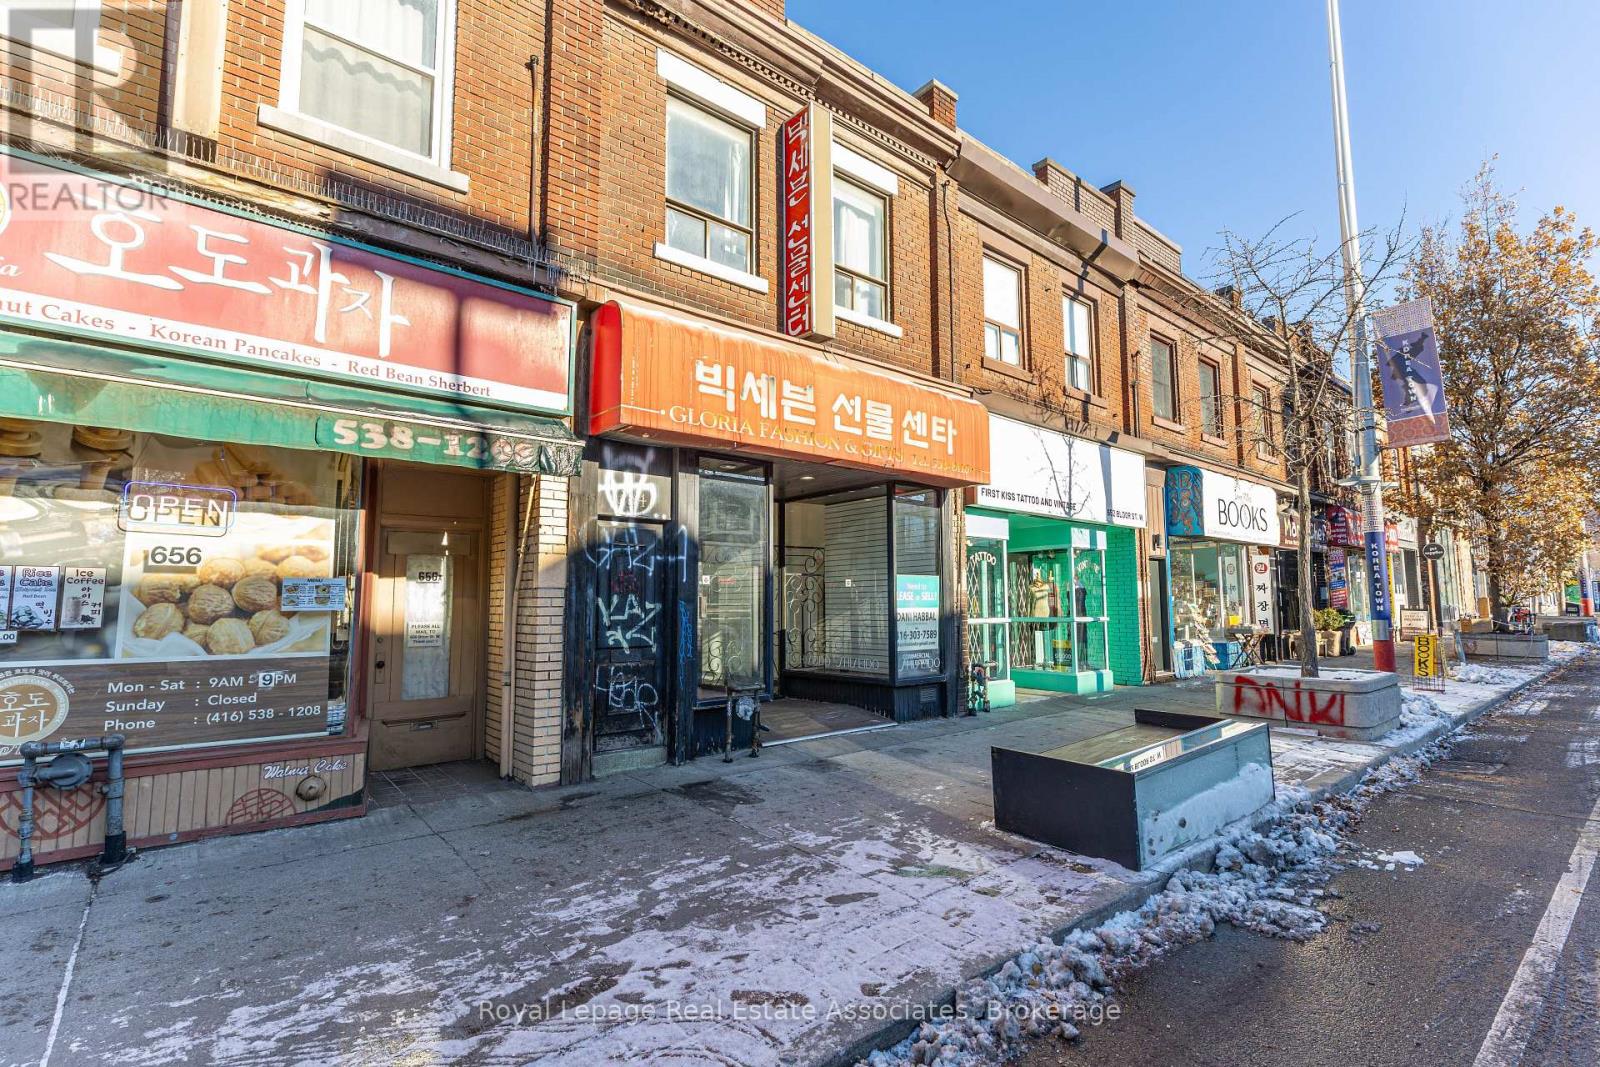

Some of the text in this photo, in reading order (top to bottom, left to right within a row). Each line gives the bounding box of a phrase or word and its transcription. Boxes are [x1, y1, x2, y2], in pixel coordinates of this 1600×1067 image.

[43, 190, 411, 358] 호도과자
[41, 303, 115, 330] Cakes
[150, 323, 226, 350] Korean
[234, 338, 321, 367] Pancakes
[348, 360, 379, 377] Red
[386, 367, 424, 385] Bean
[429, 374, 491, 397] Sherbert
[695, 360, 816, 426] 빅세븐
[669, 405, 754, 437] GLORIA
[760, 421, 840, 450] FASHION
[844, 440, 858, 454] &
[133, 494, 228, 517] OPEN
[981, 488, 1077, 511] FIRST KISS TATTOO AND VINTAGE
[1218, 498, 1268, 532] BOOKS
[151, 546, 202, 565] 656
[970, 551, 997, 565] TATTOO
[19, 578, 53, 587] Cake
[22, 568, 52, 578] Rice
[66, 577, 104, 585] Coffee
[76, 569, 94, 577] Ice
[1371, 543, 1384, 611] KOREA TOWN
[913, 612, 937, 621] HABBAL
[898, 630, 937, 641] 16-303-7589
[1418, 636, 1429, 677] BOOKS
[107, 681, 144, 694] Mon
[160, 680, 185, 691] Sat
[208, 676, 244, 688] 9AM
[105, 699, 165, 713] Sunday
[207, 693, 257, 706] Closed
[104, 719, 156, 732] Phone
[206, 711, 244, 726] (416)
[248, 708, 274, 719] 538
[288, 705, 321, 718] 1208
[264, 760, 348, 779] Walnut Cake
